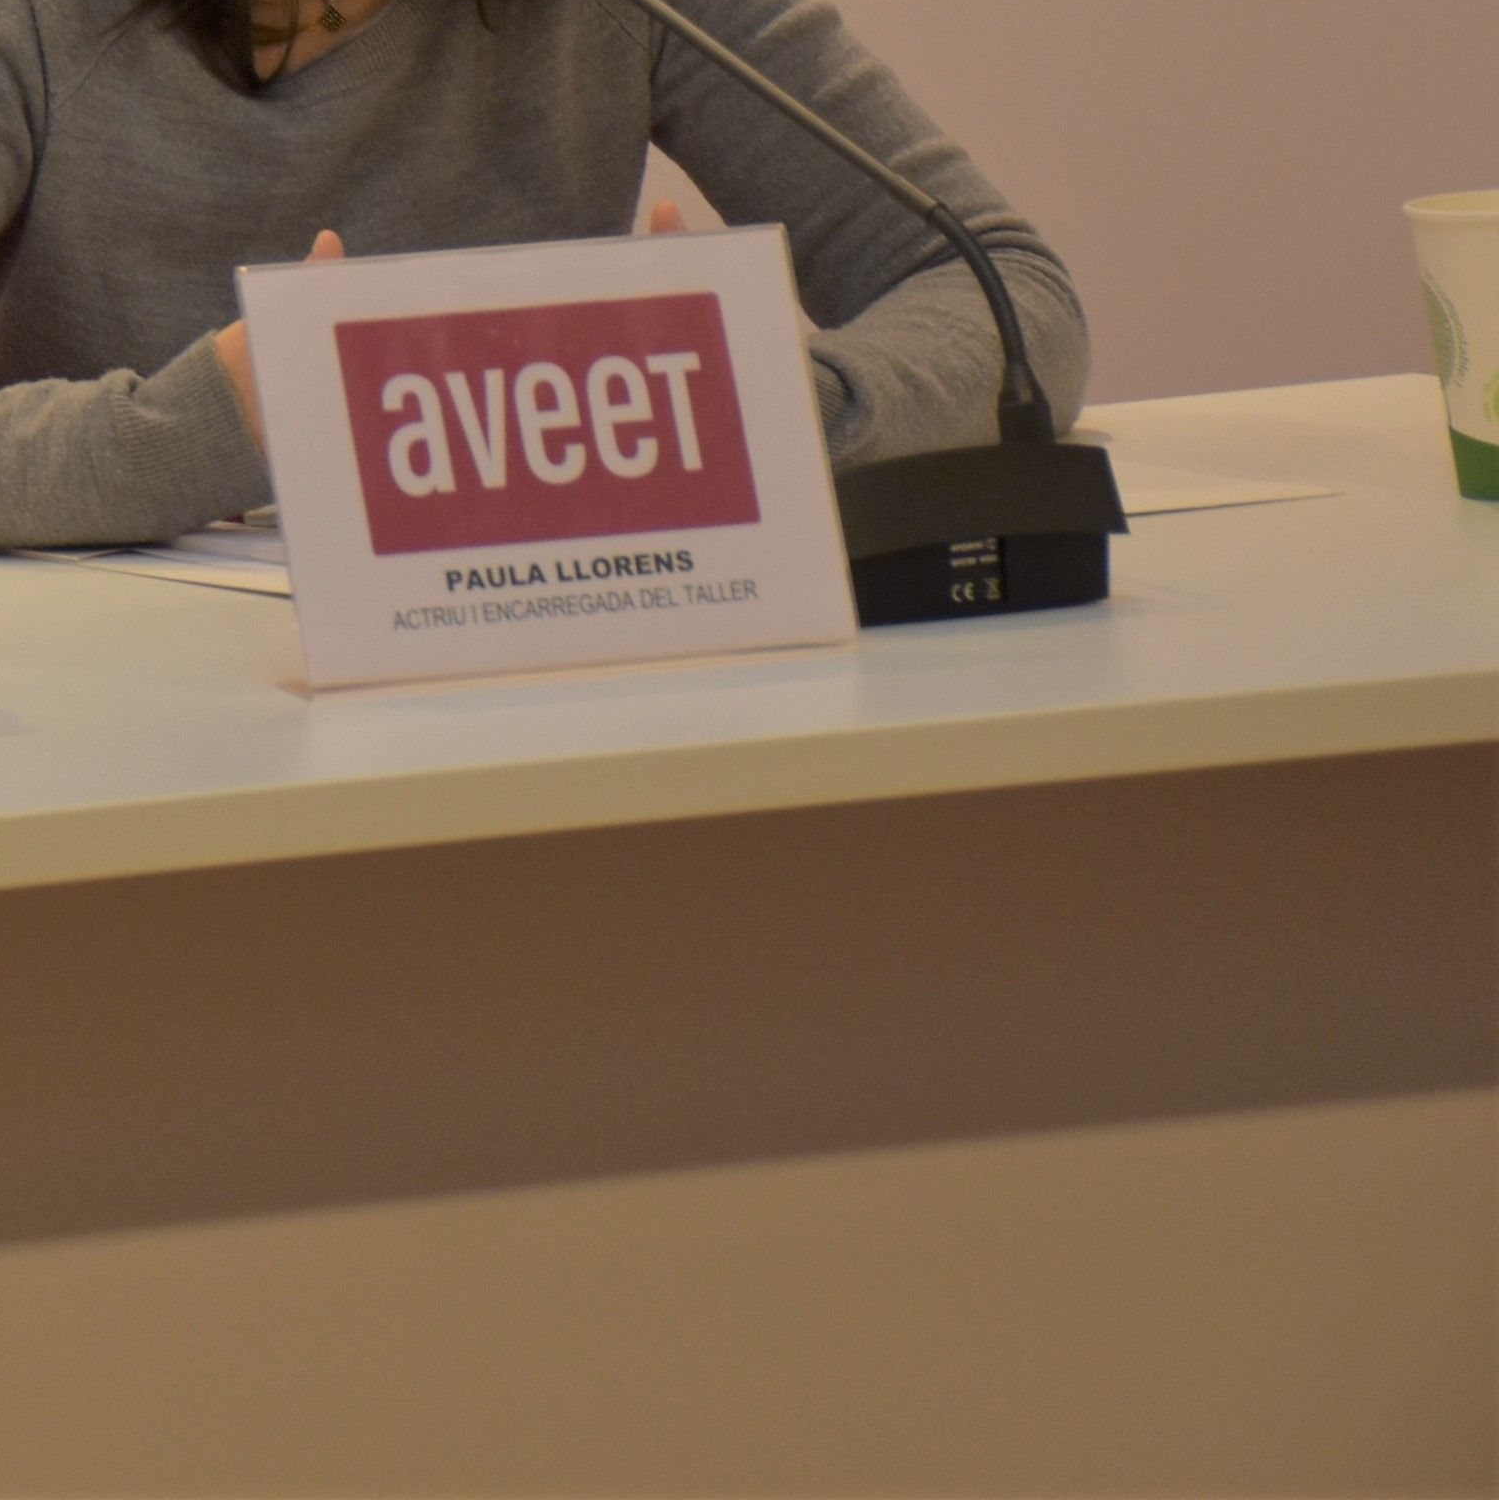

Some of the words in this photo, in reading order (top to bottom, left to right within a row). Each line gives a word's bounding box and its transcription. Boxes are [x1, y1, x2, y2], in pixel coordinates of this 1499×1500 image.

[446, 563, 547, 592] PAULA
[556, 550, 695, 582] LLORENS
[393, 603, 467, 631] ACTRIU
[471, 605, 479, 624] I
[484, 591, 635, 625] ENCARREGADA
[641, 587, 678, 610] DEL
[687, 579, 759, 606] TALLER
